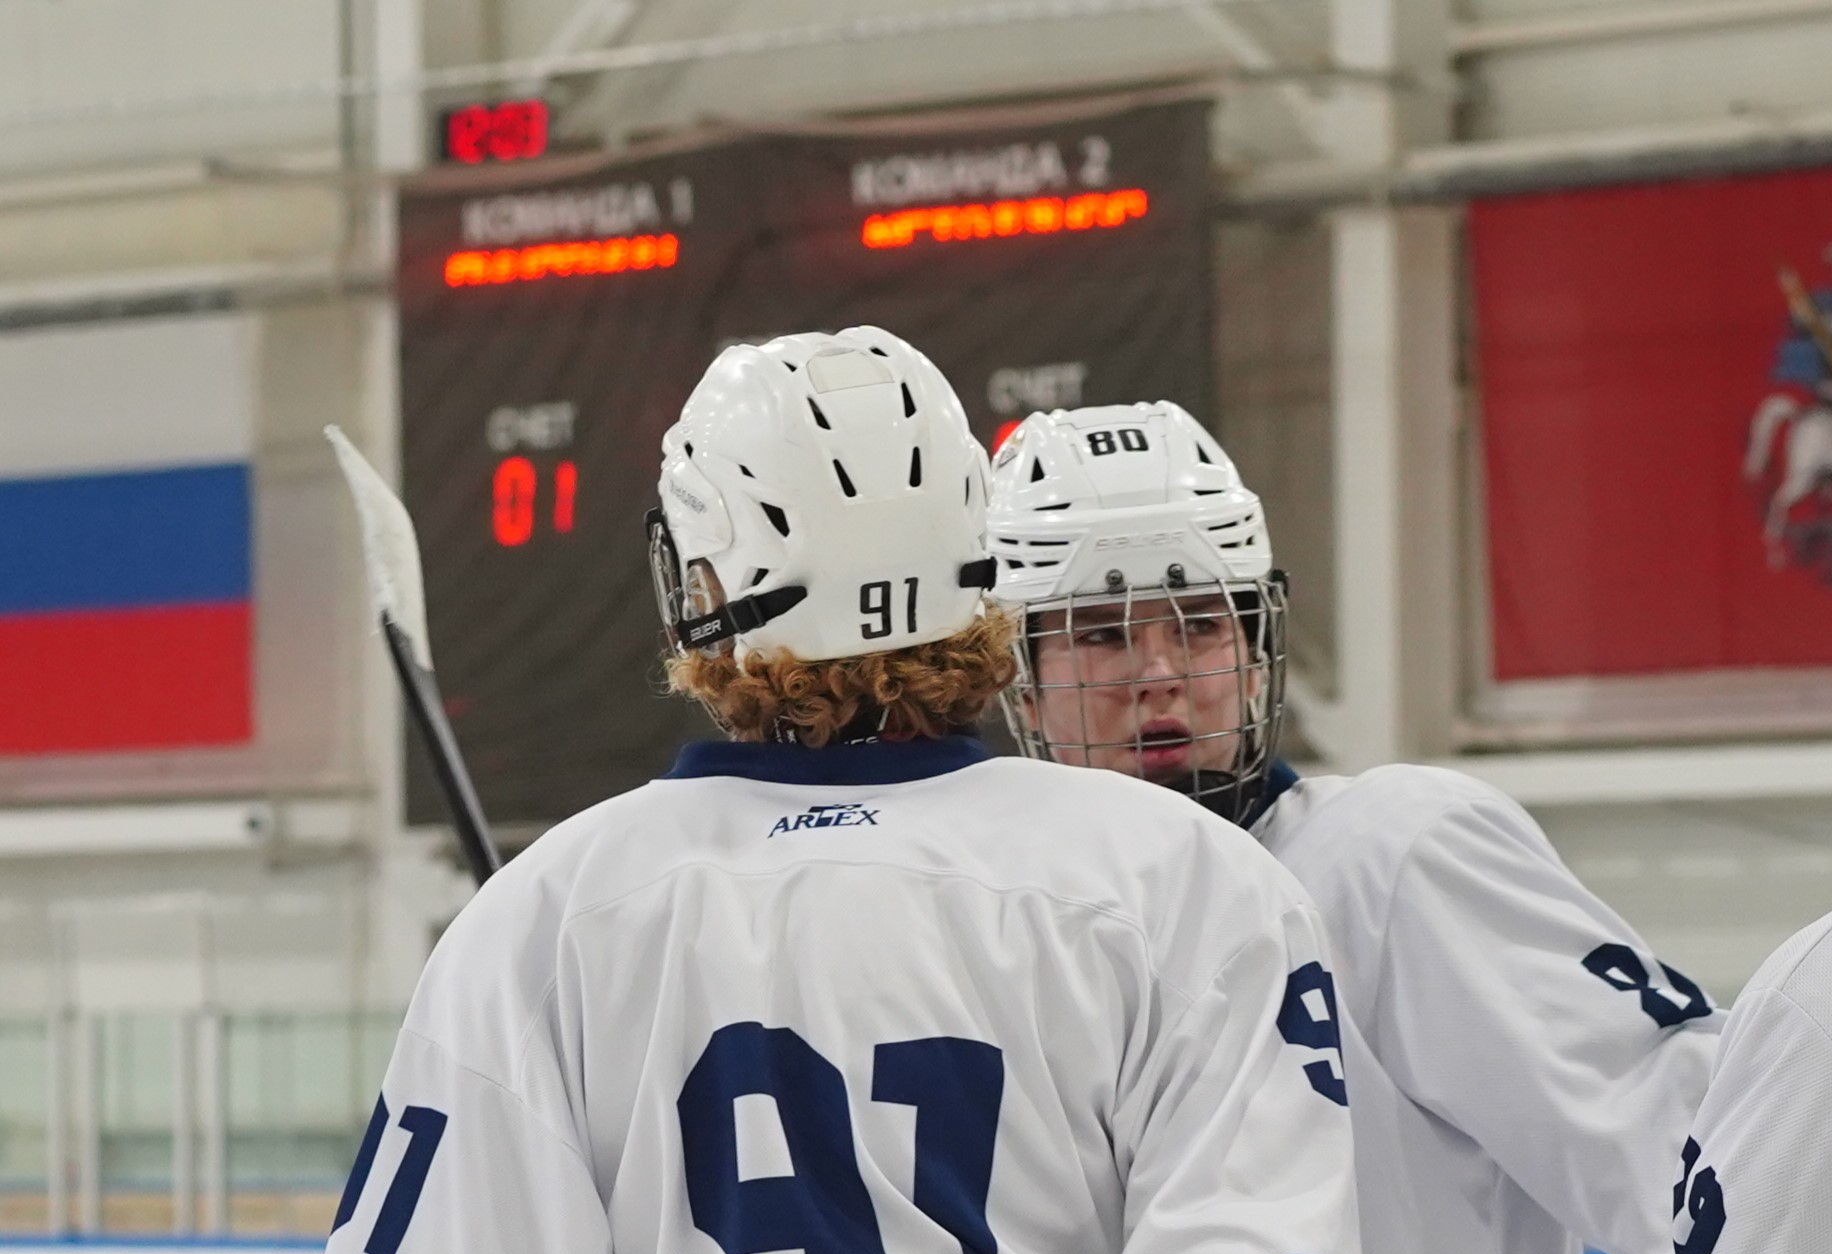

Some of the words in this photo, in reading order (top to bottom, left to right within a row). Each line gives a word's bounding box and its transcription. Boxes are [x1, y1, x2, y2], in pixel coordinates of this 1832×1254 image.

[1087, 429, 1149, 457] 80
[493, 456, 578, 547] 01
[860, 577, 919, 640] 91
